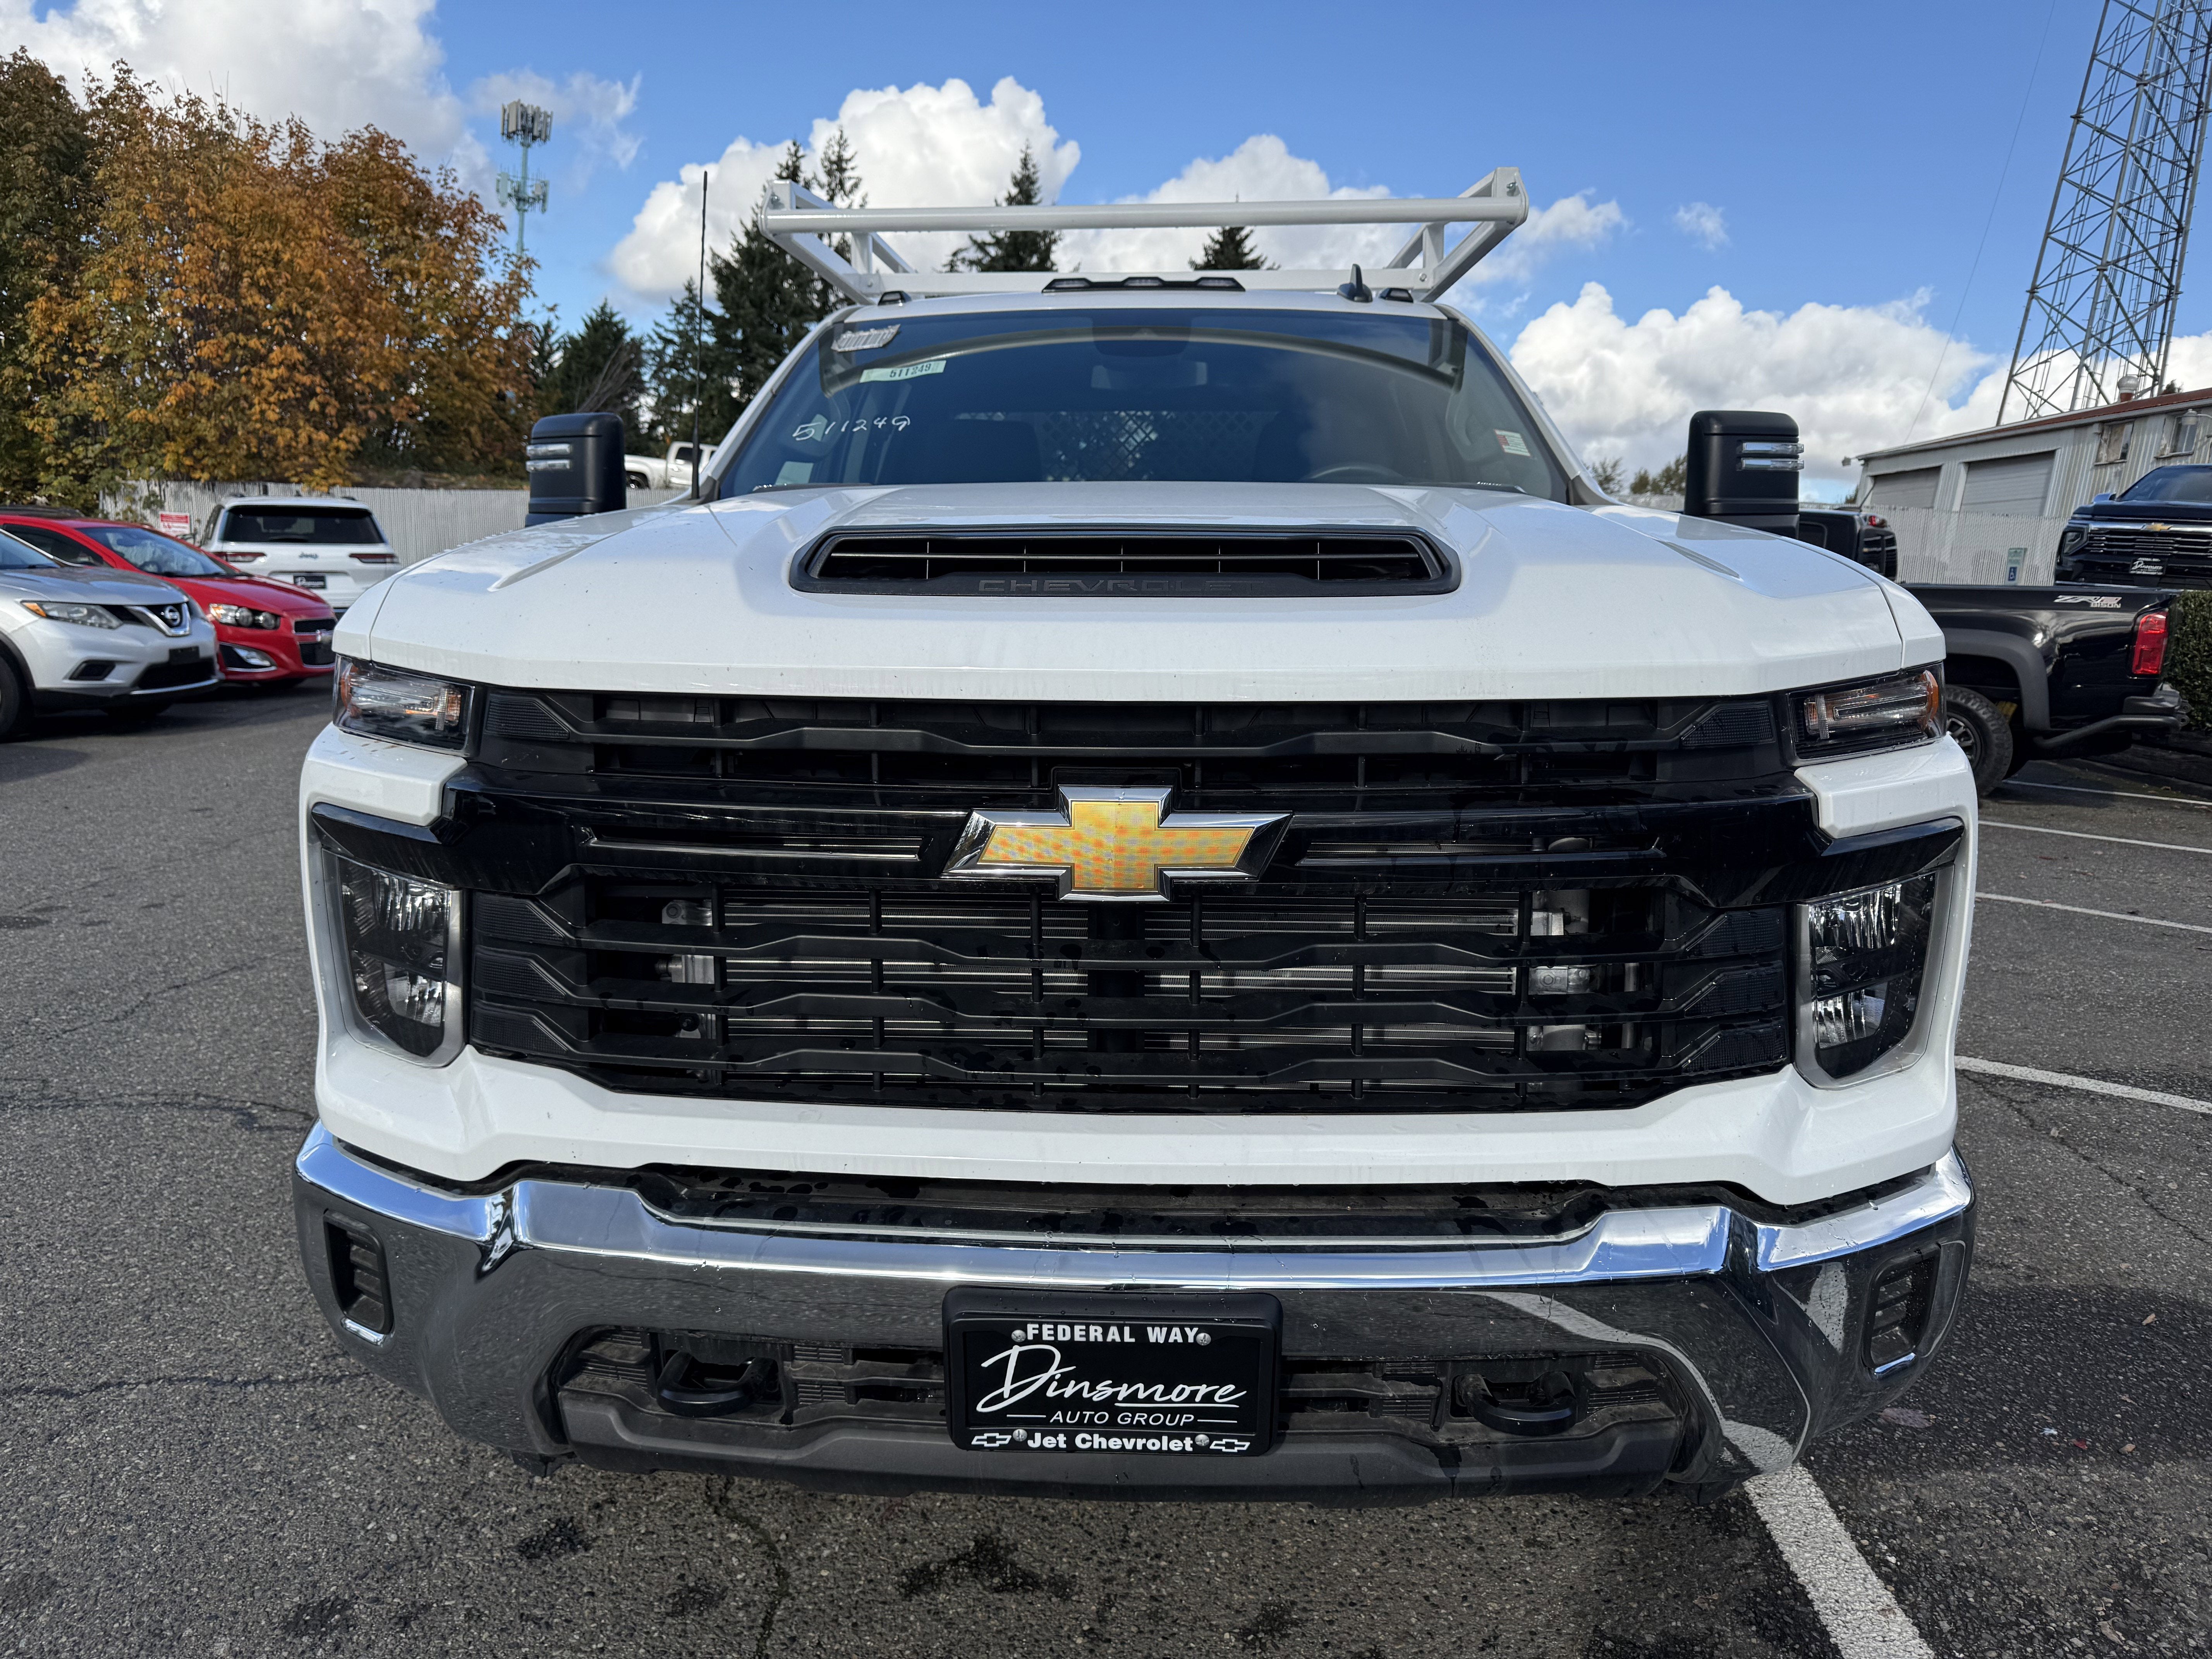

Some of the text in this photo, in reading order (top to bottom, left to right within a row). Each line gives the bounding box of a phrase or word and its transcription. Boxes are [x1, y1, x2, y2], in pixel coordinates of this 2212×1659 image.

[890, 363, 931, 378] 511249
[792, 415, 910, 441] 511249
[978, 579, 1263, 592] CHEVROLET
[1027, 1323, 1199, 1343] FEDERAL WAY
[976, 1345, 1247, 1413] Dinsmore
[1049, 1410, 1195, 1427] AUTO GROUP
[1027, 1432, 1194, 1452] Jet Chevrolet
